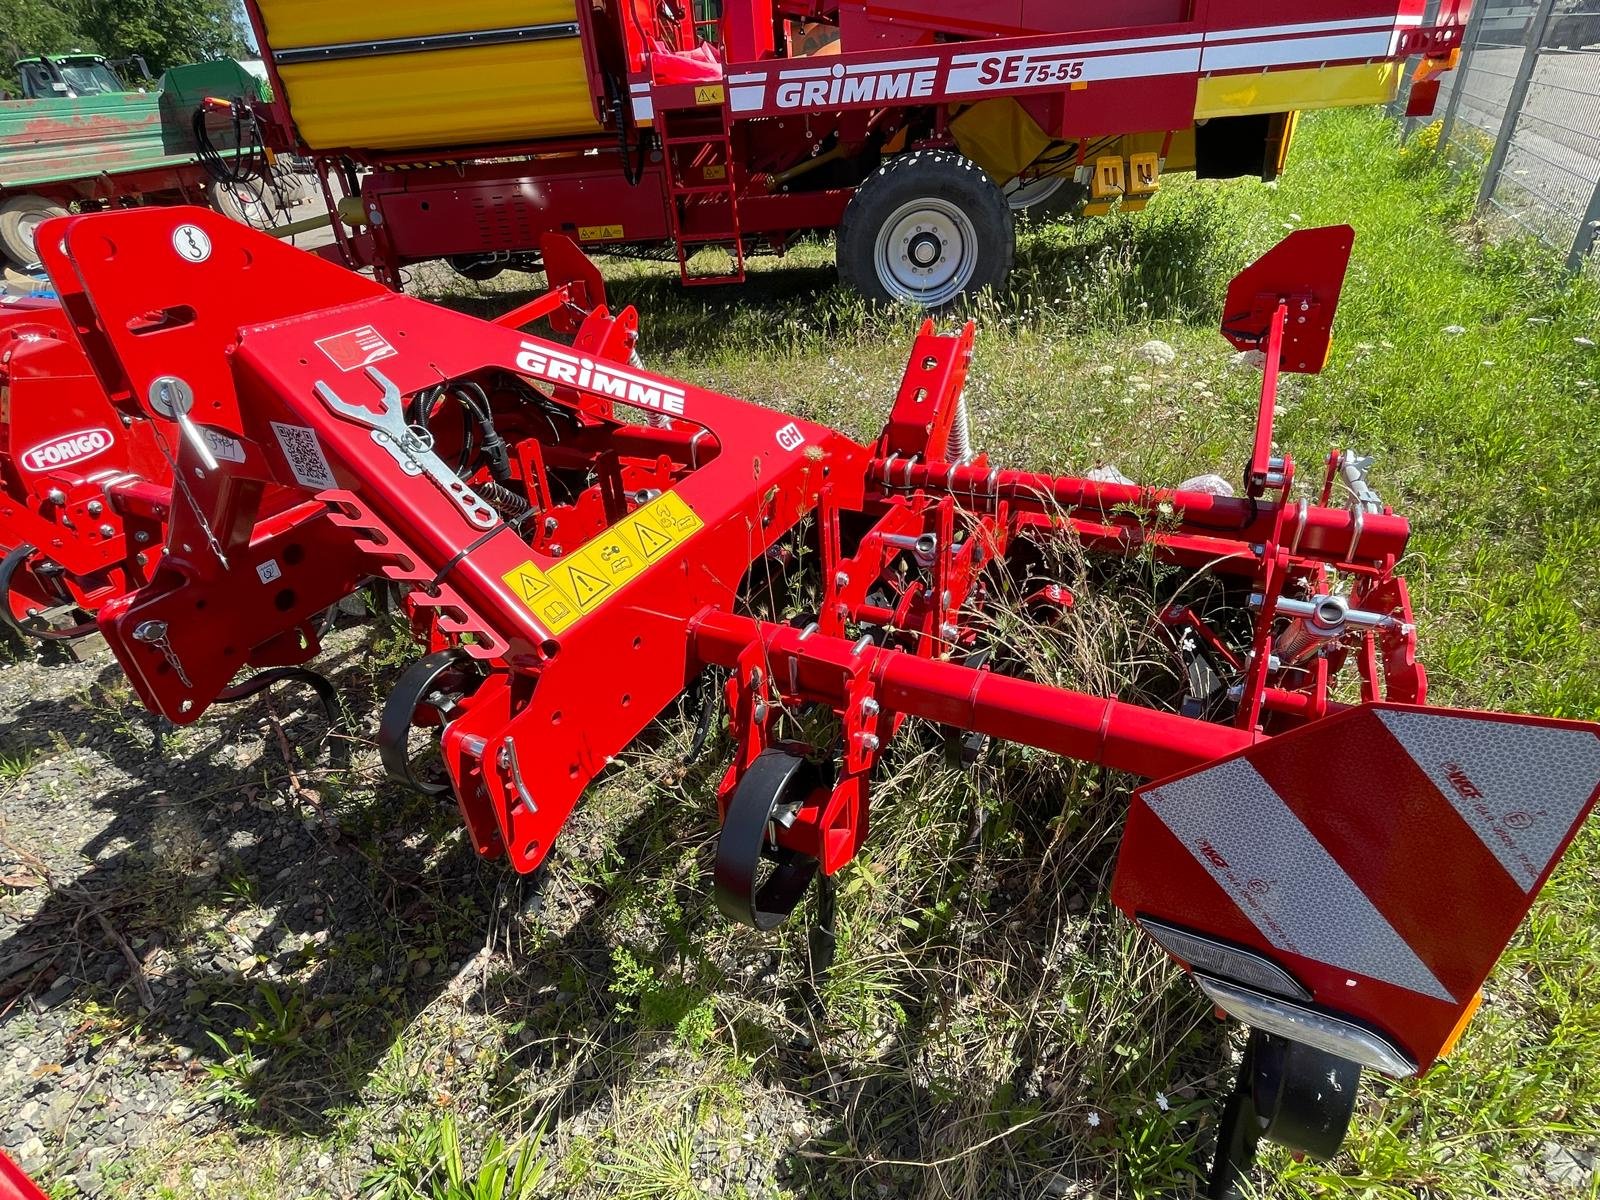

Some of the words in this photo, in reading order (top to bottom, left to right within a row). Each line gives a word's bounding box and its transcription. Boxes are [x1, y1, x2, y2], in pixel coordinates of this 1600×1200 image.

[978, 55, 1023, 85] SE
[1024, 61, 1084, 83] 75-55
[31, 432, 105, 468] FORIGO
[779, 426, 802, 448] GH
